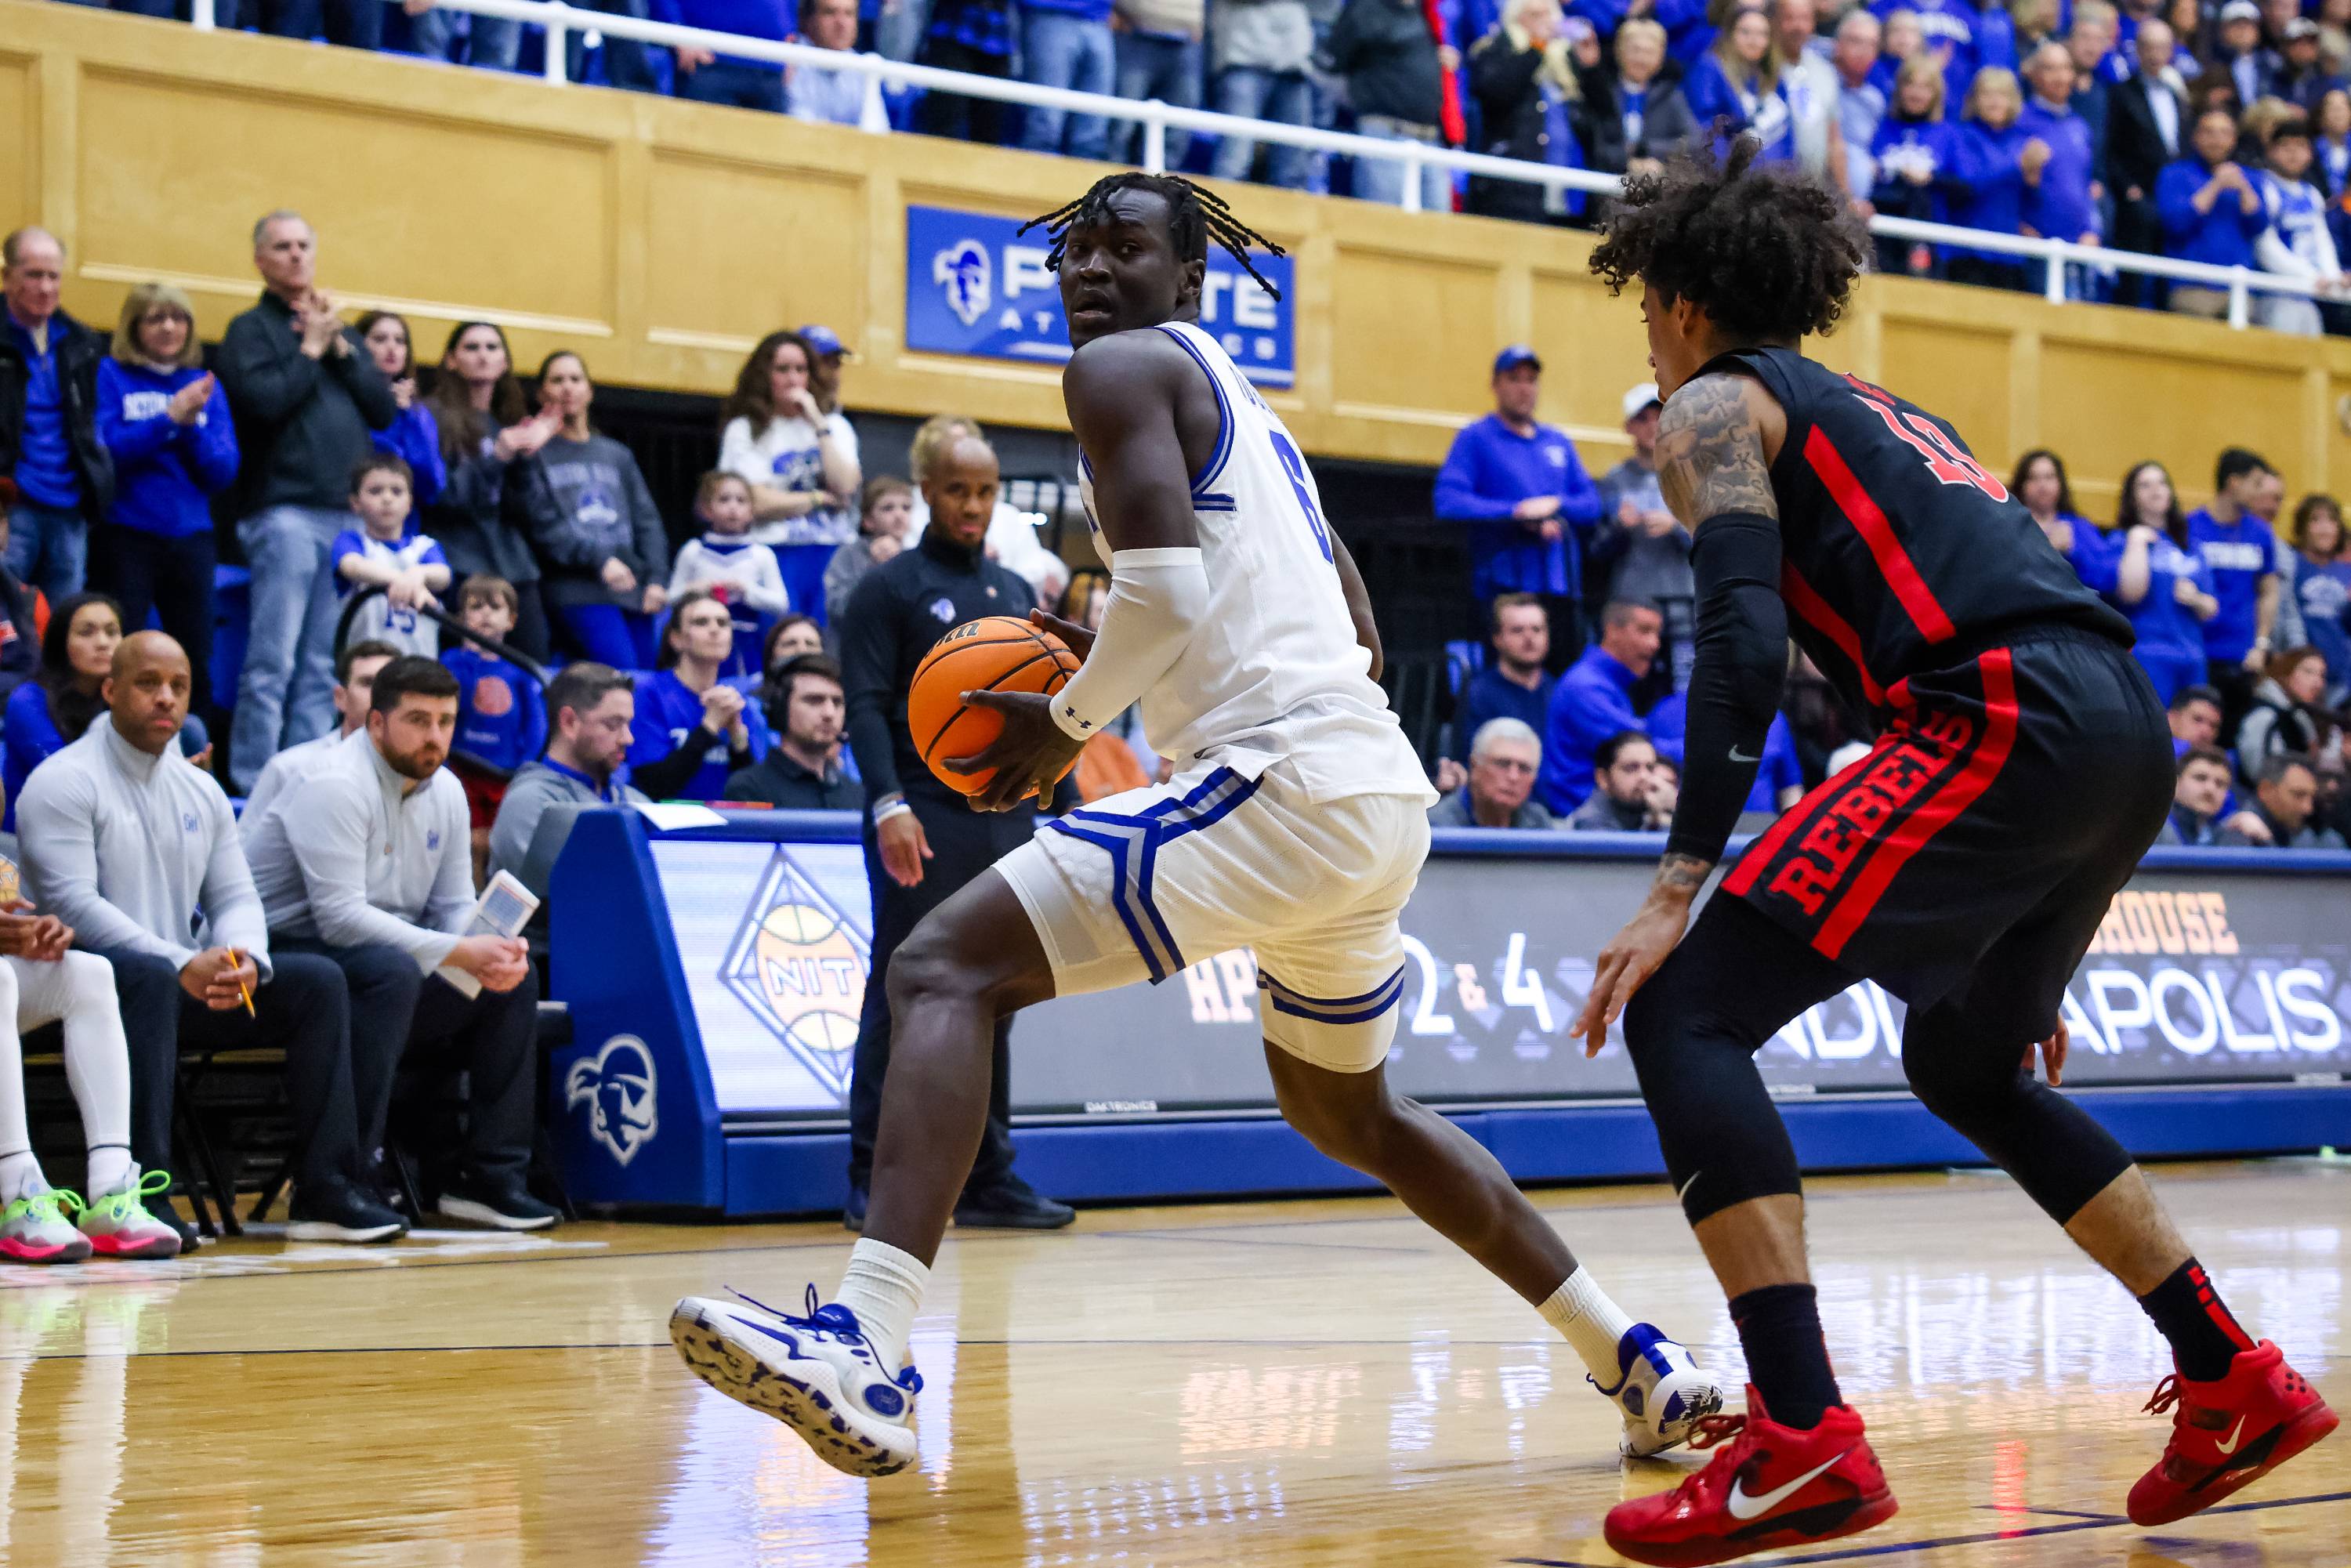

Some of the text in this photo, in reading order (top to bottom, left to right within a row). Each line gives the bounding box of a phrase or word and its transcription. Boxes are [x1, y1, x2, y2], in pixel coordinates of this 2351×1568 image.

[1002, 244, 1279, 330] PTE
[1768, 711, 1972, 916] REBELS
[2081, 891, 2240, 955] HOUSE
[765, 958, 854, 996] NIT
[1401, 933, 1455, 1034] 2
[1454, 963, 1488, 1012] &
[1502, 932, 1555, 1033] 4
